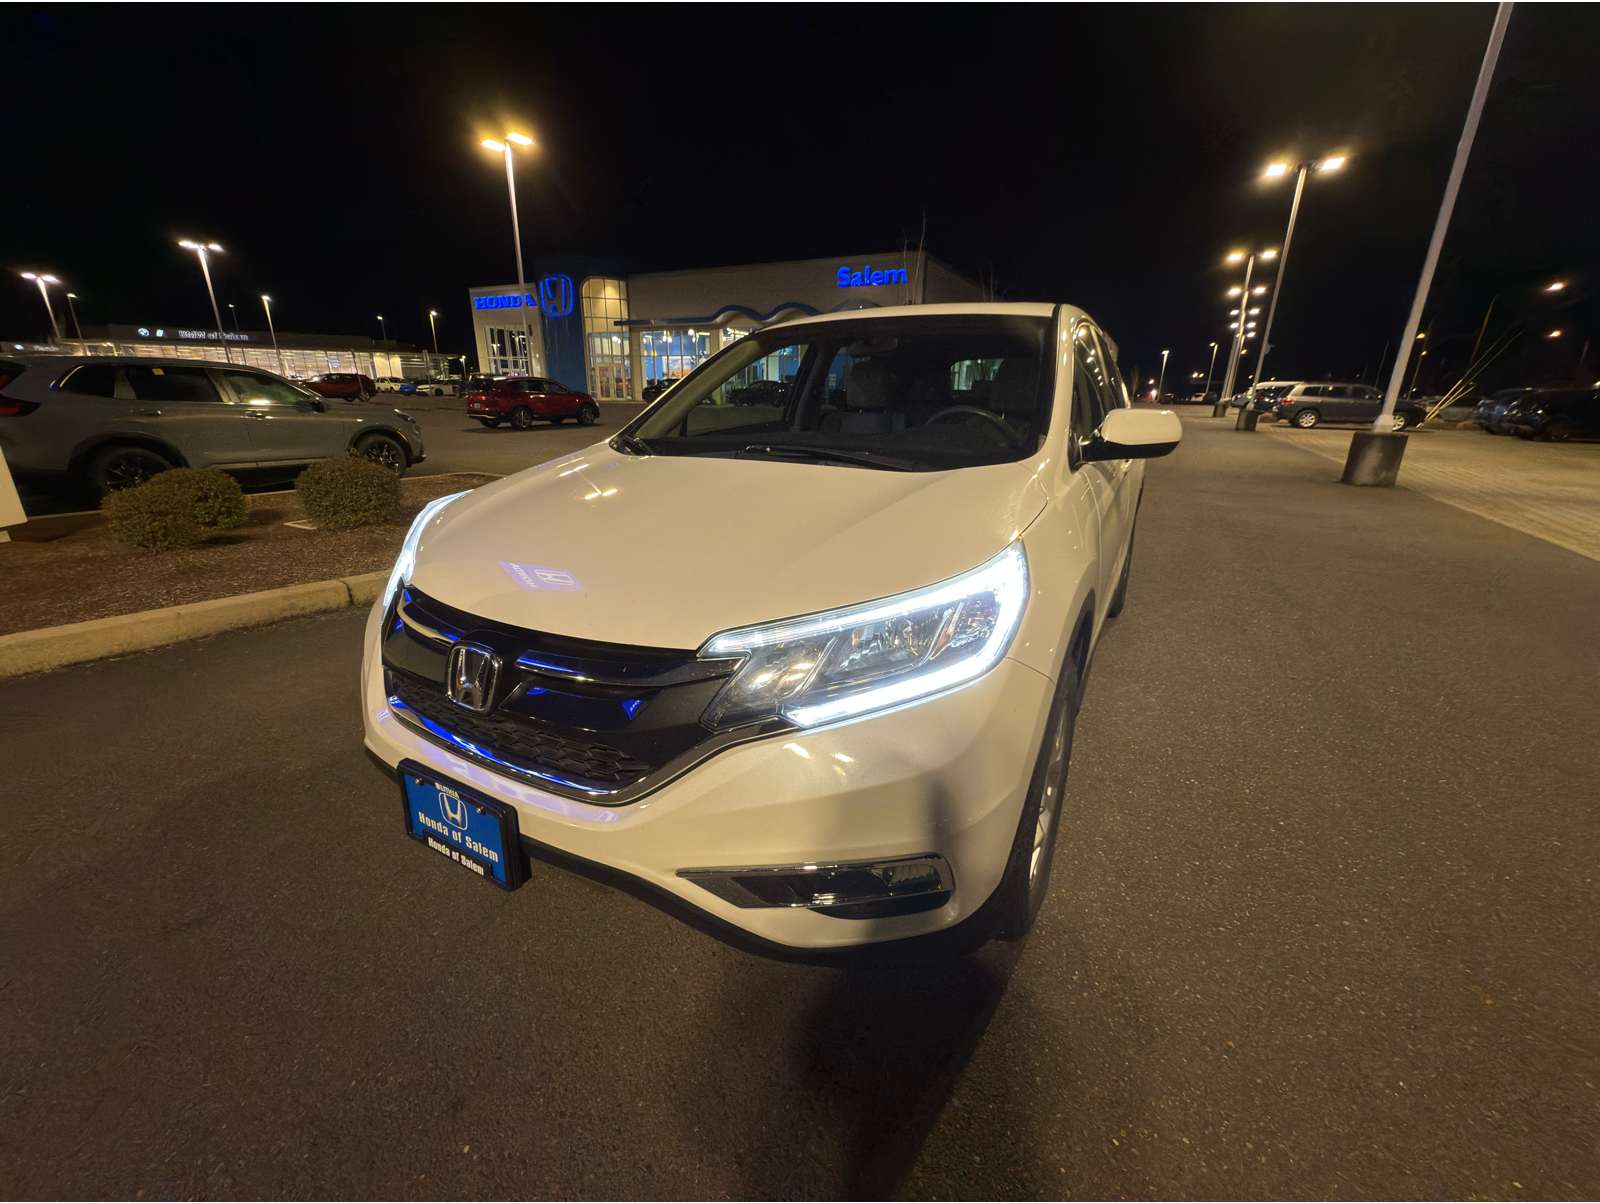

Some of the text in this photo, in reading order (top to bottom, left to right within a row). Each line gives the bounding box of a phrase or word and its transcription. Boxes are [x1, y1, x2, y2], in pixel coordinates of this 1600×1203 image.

[836, 264, 908, 288] Salem
[474, 292, 537, 310] HONDA
[418, 811, 499, 864] Honda of Salem
[427, 836, 485, 876] Honda of Salem
